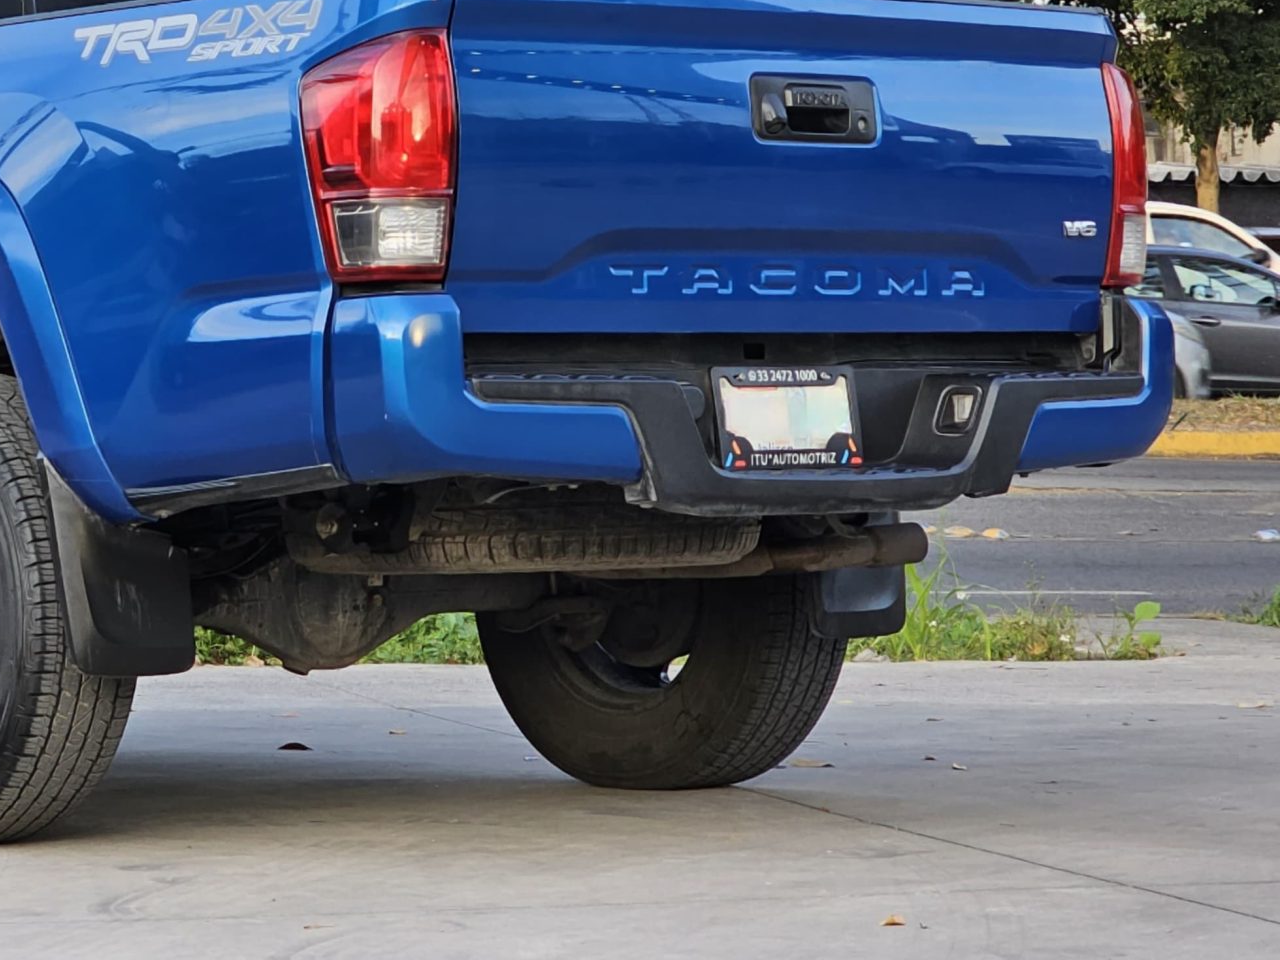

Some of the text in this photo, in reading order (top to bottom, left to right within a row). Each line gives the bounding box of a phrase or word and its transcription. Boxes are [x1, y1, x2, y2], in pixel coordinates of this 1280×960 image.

[74, 14, 198, 66] TRD
[187, 33, 311, 62] SPORT
[794, 91, 848, 106] TOYOTA
[1062, 220, 1098, 237] V6
[608, 263, 985, 296] TACOMA
[770, 370, 794, 382] 2472
[795, 369, 818, 381] 1000
